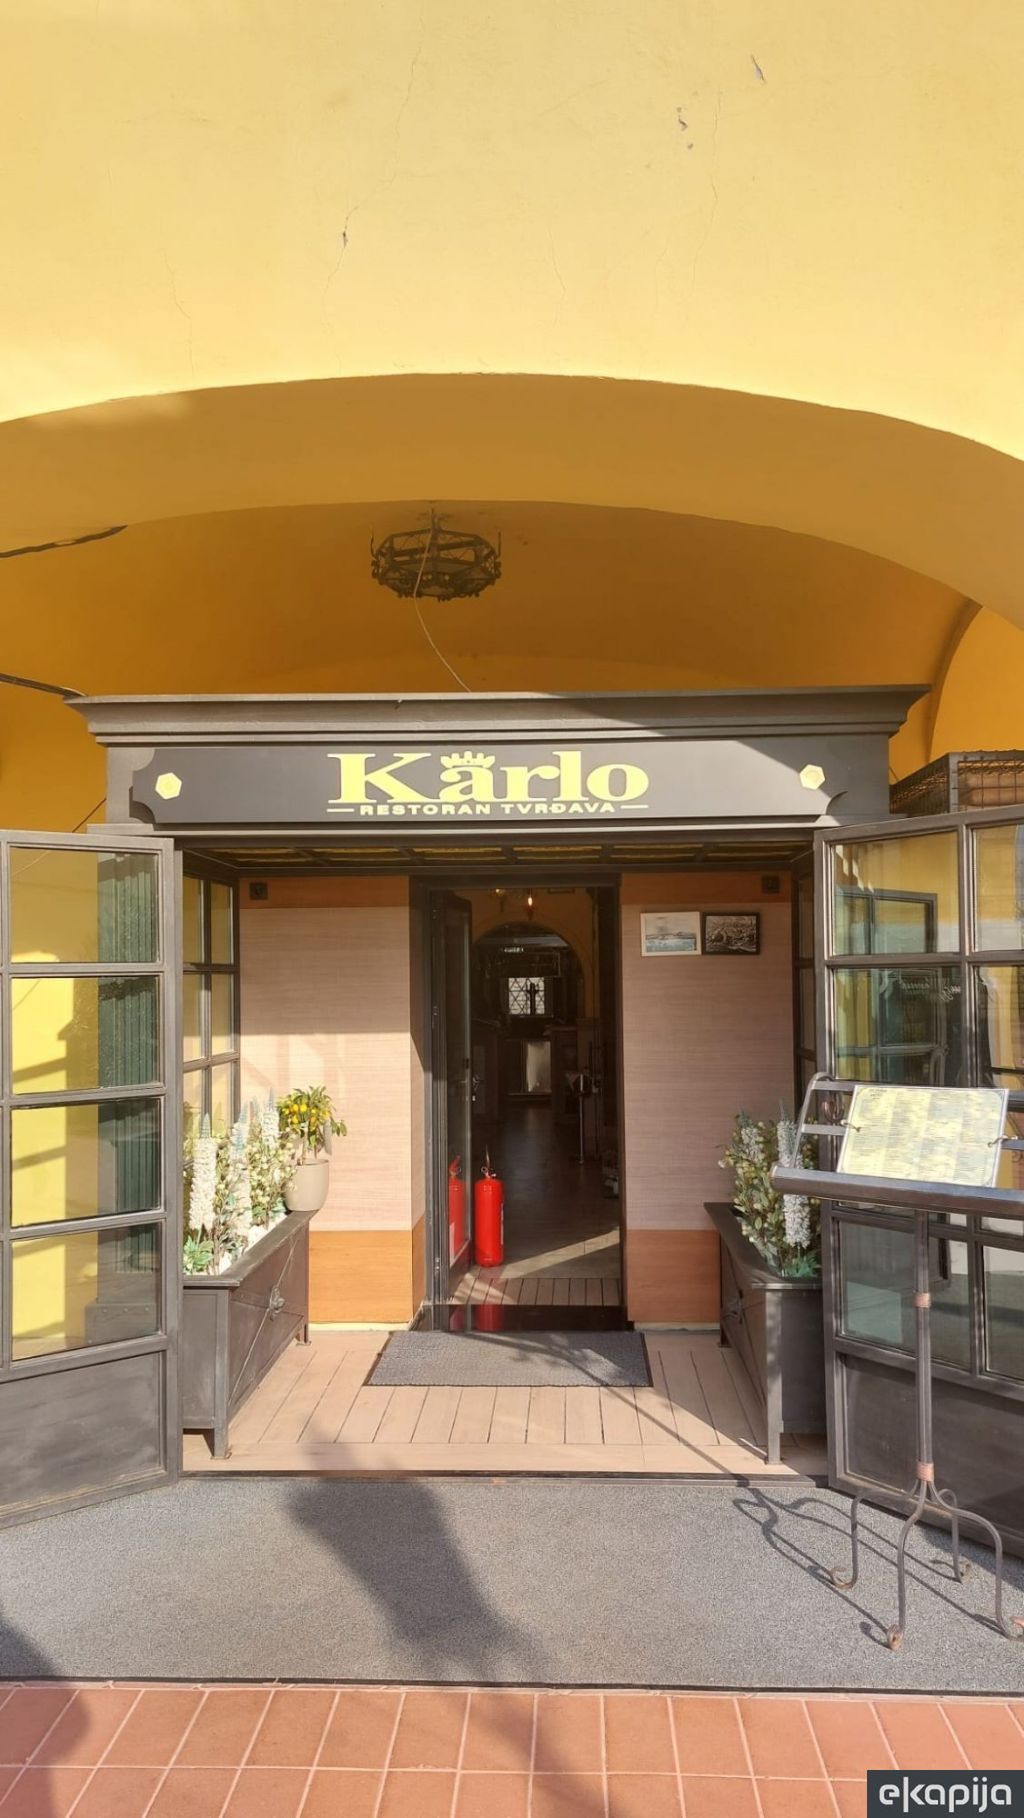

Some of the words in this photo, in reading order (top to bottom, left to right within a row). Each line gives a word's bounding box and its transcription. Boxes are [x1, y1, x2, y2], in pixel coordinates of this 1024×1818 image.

[327, 750, 649, 804] Karlo
[360, 803, 490, 816] RESTORAN
[501, 802, 615, 815] TVRĐAVA
